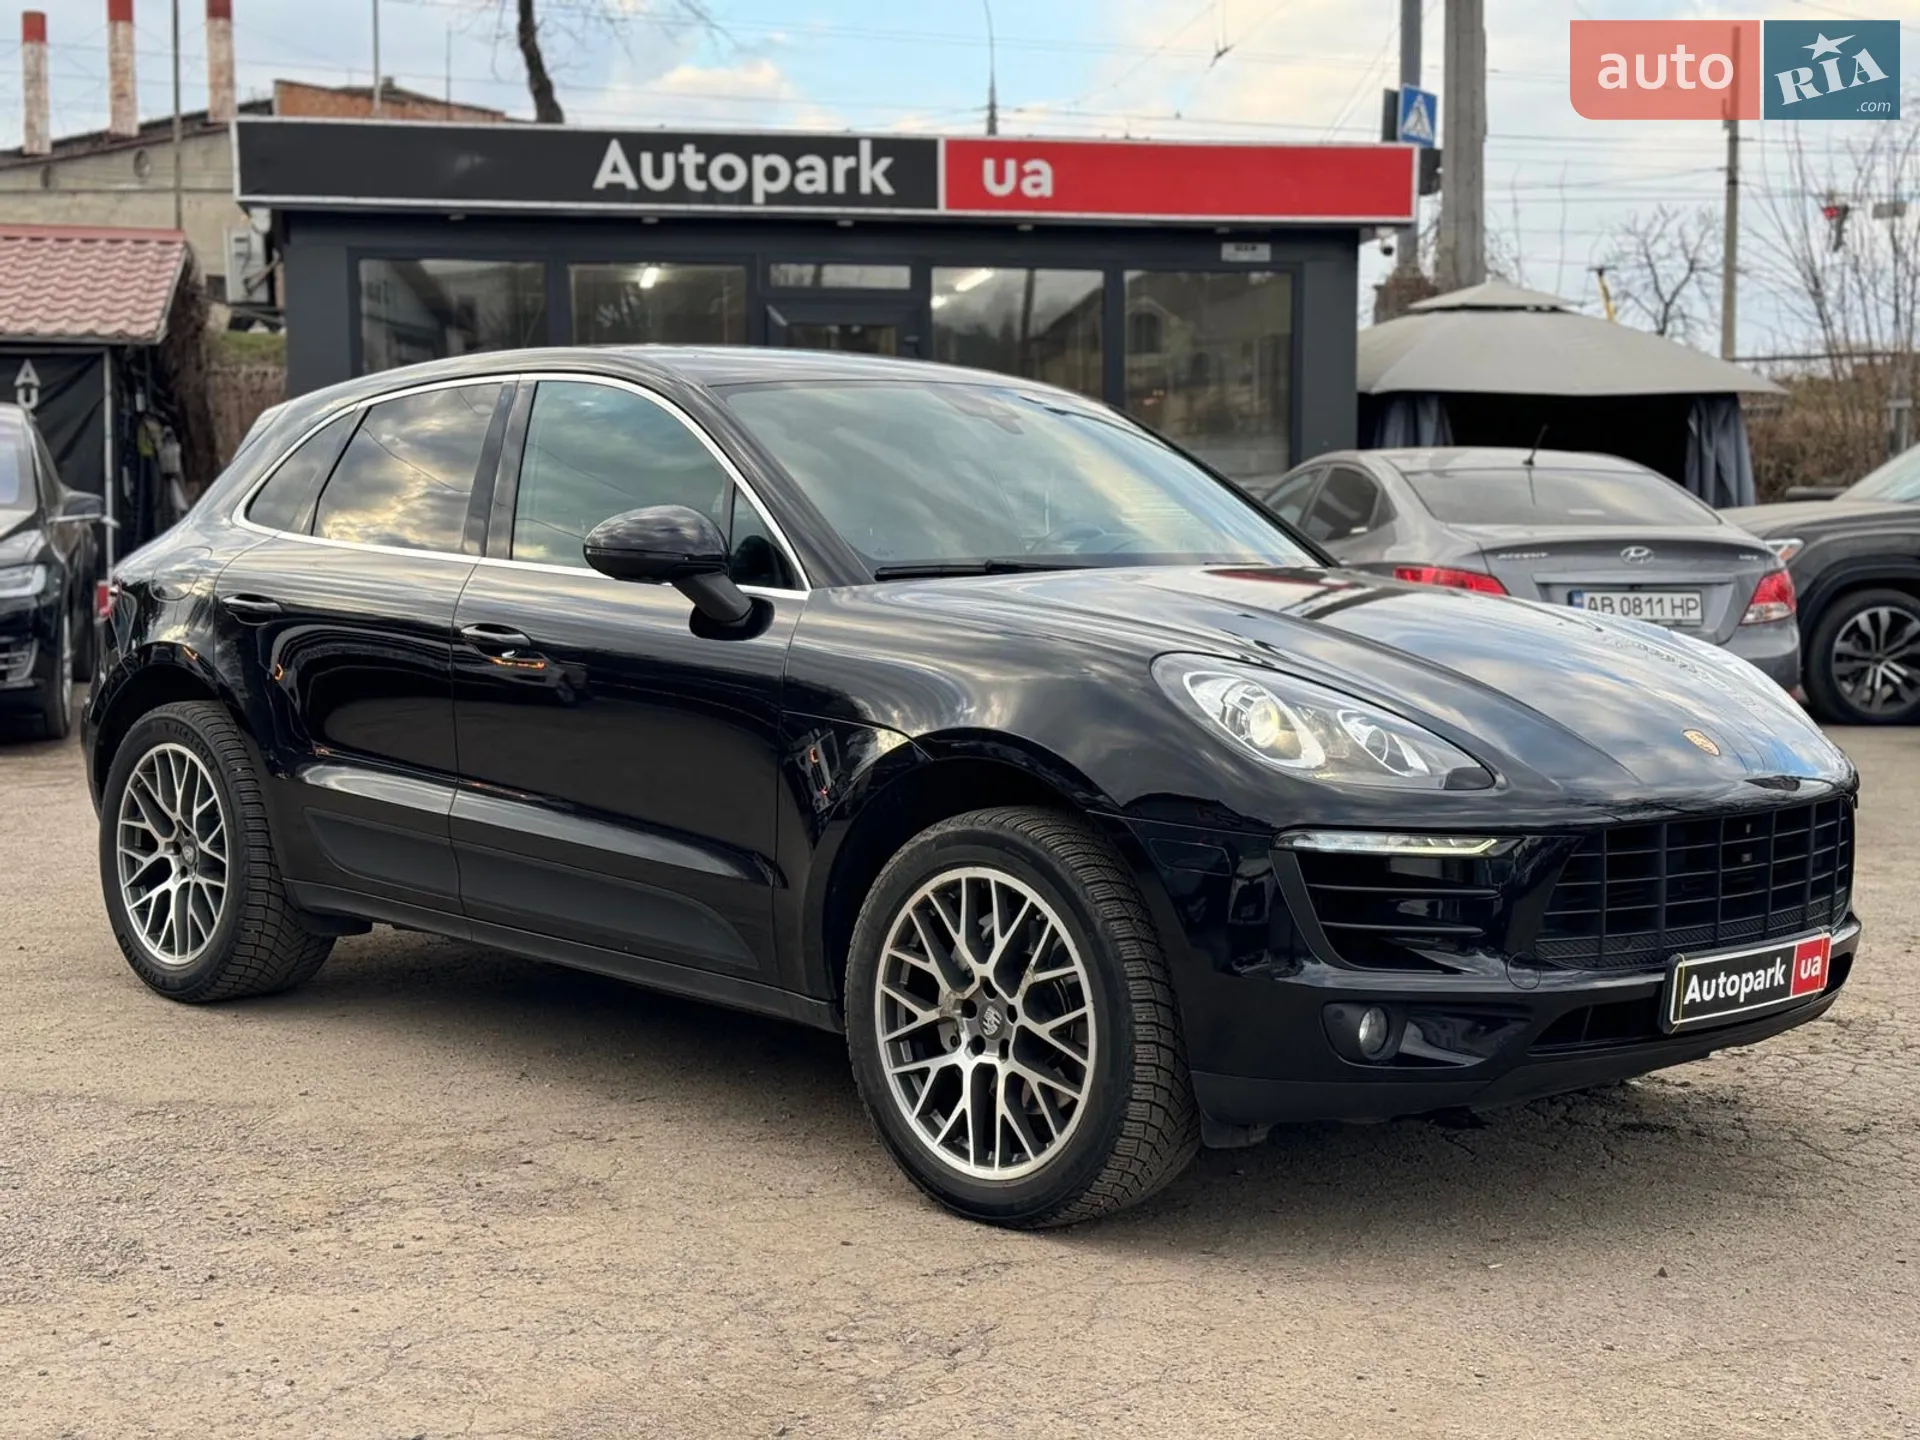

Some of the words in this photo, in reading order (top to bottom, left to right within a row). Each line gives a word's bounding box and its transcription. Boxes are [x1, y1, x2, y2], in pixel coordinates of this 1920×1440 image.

[593, 138, 895, 205] Autopark
[983, 157, 1054, 197] ua
[1587, 596, 1615, 615] AB
[1620, 596, 1665, 617] 0811
[1671, 597, 1700, 617] HP
[1683, 956, 1787, 1005] Autopark
[1800, 955, 1822, 981] ua
